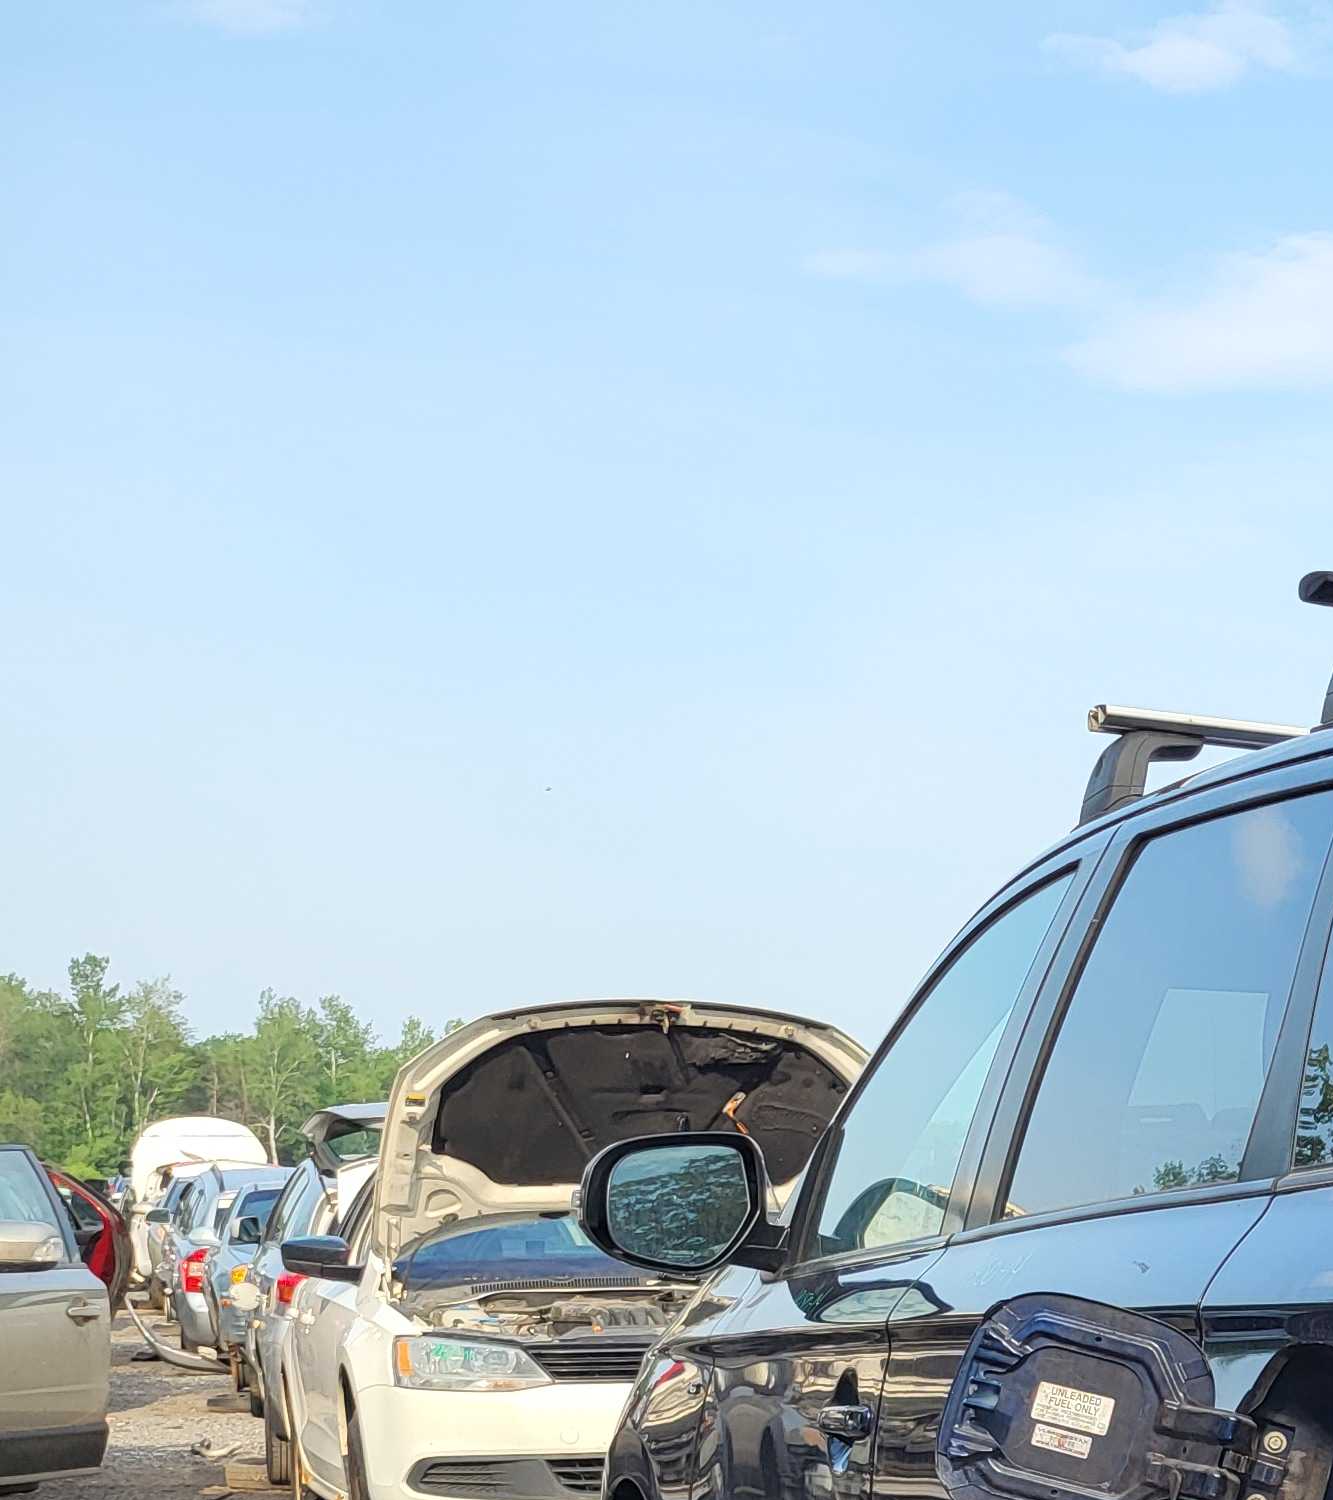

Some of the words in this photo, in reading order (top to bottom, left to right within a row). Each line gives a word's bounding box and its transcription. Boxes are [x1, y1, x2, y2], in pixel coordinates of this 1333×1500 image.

[1048, 1396, 1072, 1410] FUEL
[1074, 1403, 1100, 1416] ONLY
[1051, 1386, 1102, 1407] UNLEADED
